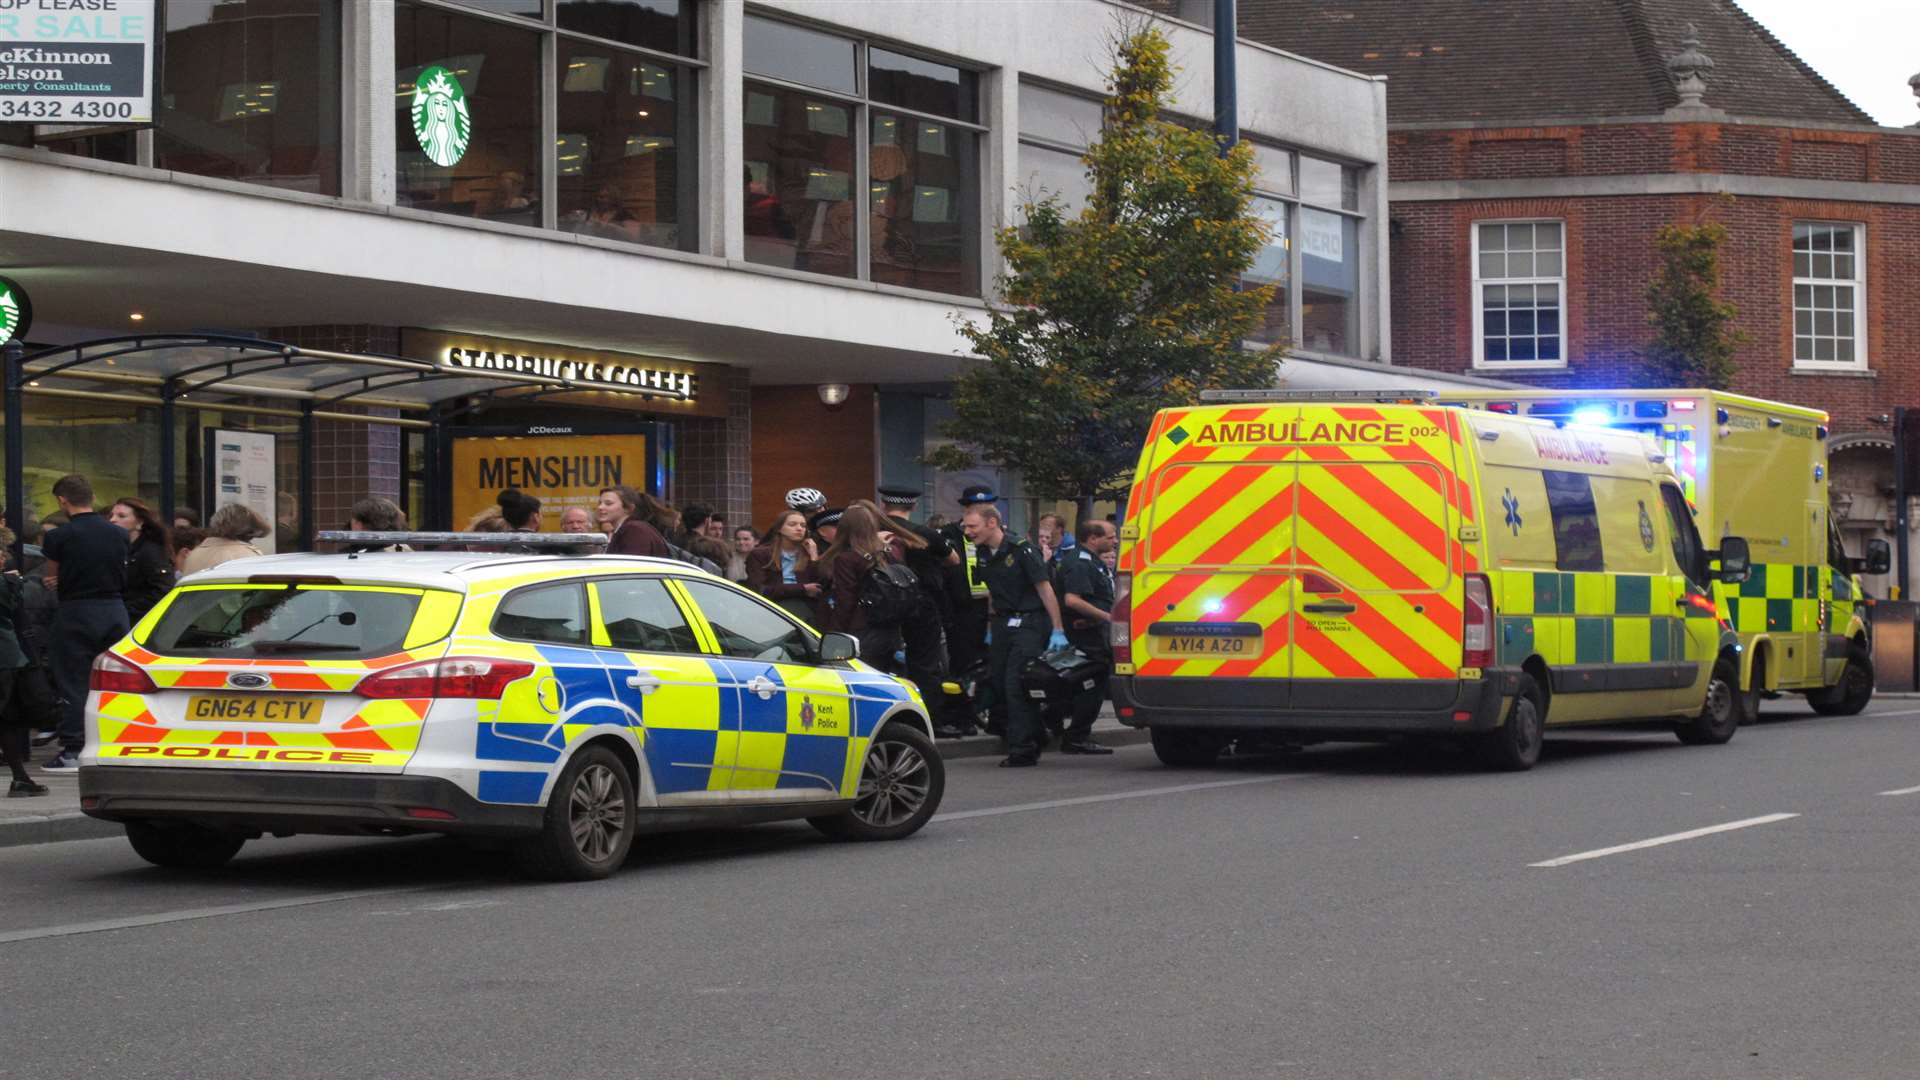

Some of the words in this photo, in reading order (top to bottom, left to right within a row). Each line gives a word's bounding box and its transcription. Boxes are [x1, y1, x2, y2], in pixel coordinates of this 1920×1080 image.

[39, 0, 117, 10] LEASE
[34, 16, 144, 39] SALE
[33, 82, 111, 91] Consultants
[2, 101, 62, 117] 3432
[71, 102, 132, 118] 4300
[610, 366, 700, 400] COFFEE
[1197, 423, 1405, 443] AMBULANCE
[1410, 427, 1440, 437] 002
[1536, 433, 1609, 465] AMBULANCE
[478, 455, 623, 488] MENSHUN
[1169, 639, 1204, 651] AY14
[195, 699, 257, 718] GN64
[263, 700, 313, 719] CTV
[818, 704, 833, 714] Kent
[818, 718, 838, 728] Police
[119, 746, 374, 763] POLICE
